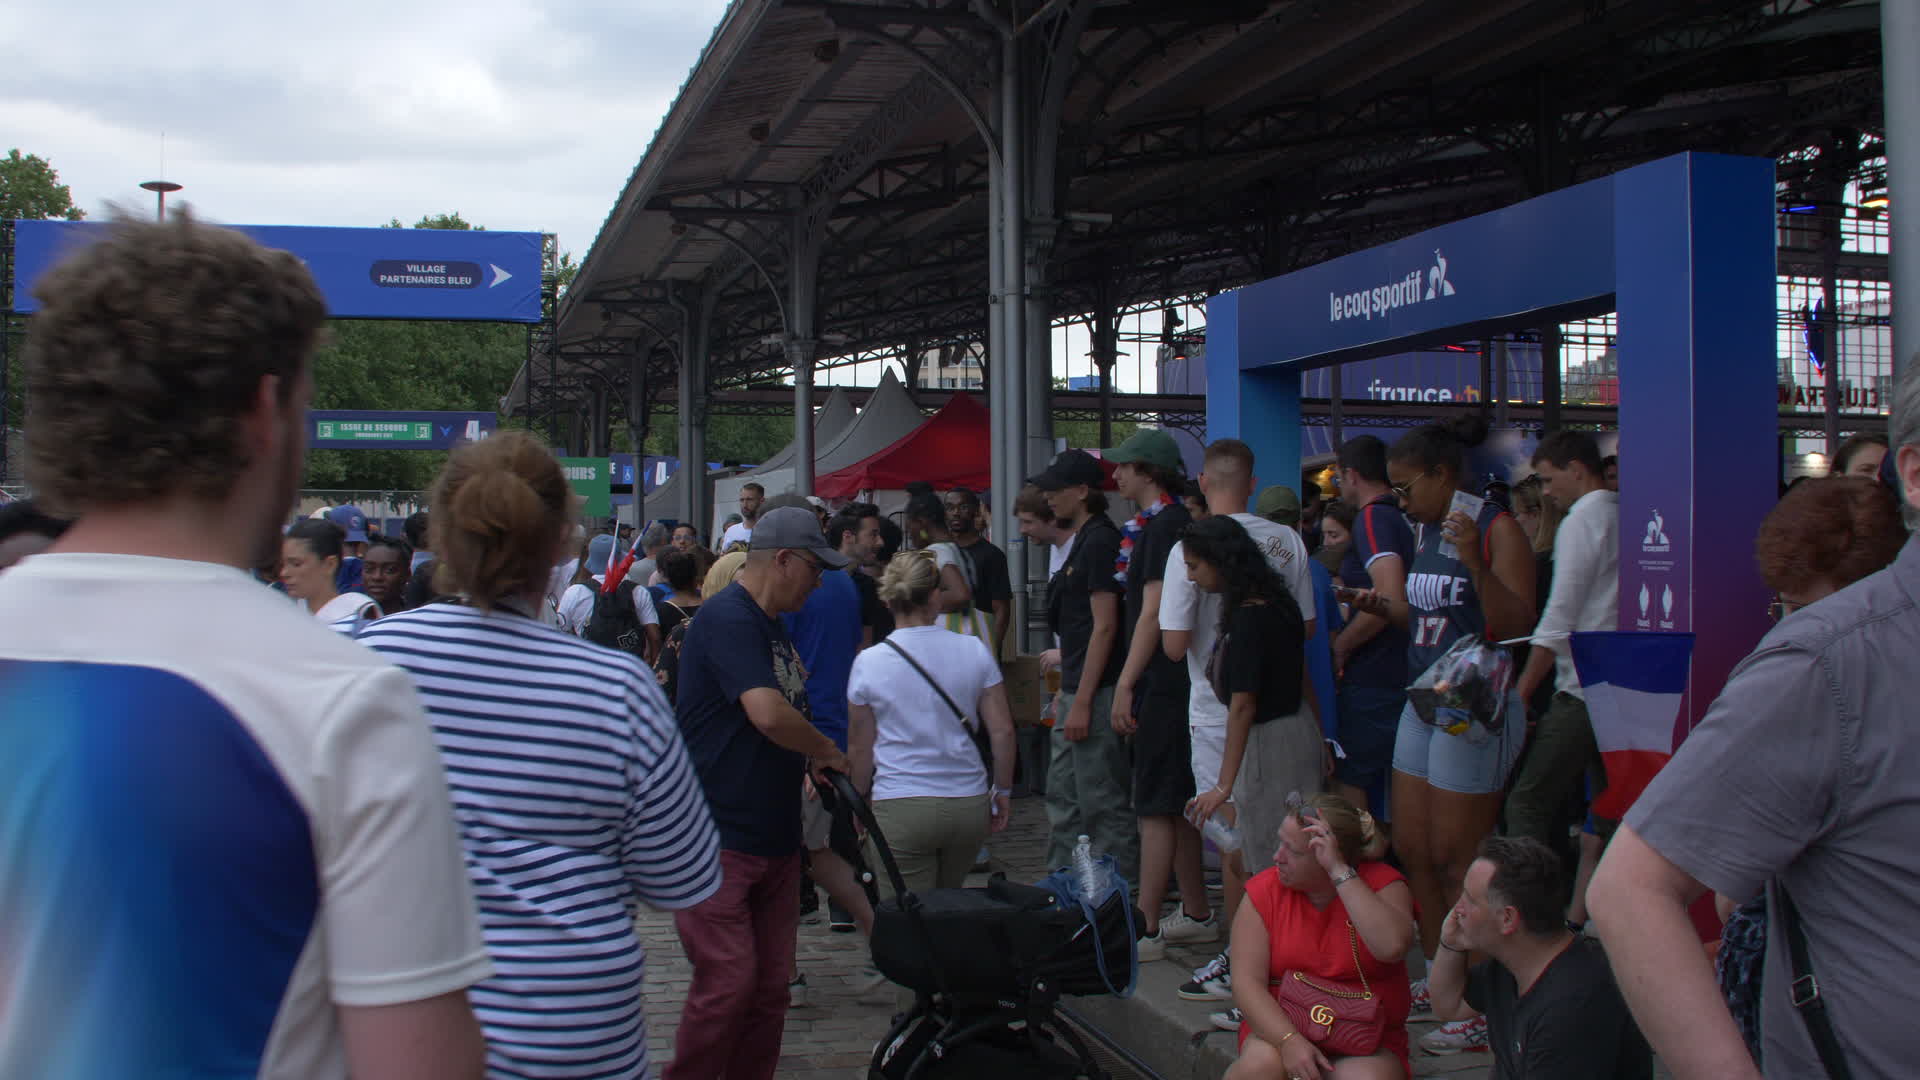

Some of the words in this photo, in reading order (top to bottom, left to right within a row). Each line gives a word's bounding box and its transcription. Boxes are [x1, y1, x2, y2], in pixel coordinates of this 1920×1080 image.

[406, 264, 447, 273] VILLAGE
[379, 275, 446, 285] PARTENAIRES
[447, 276, 472, 285] BLEU
[1329, 291, 1343, 322] le
[1343, 289, 1371, 321] coq
[1372, 270, 1422, 318] sportif
[340, 423, 362, 432] ISSUE
[363, 423, 373, 432] DE
[374, 423, 409, 432] SECOURS
[1415, 615, 1449, 647] 17
